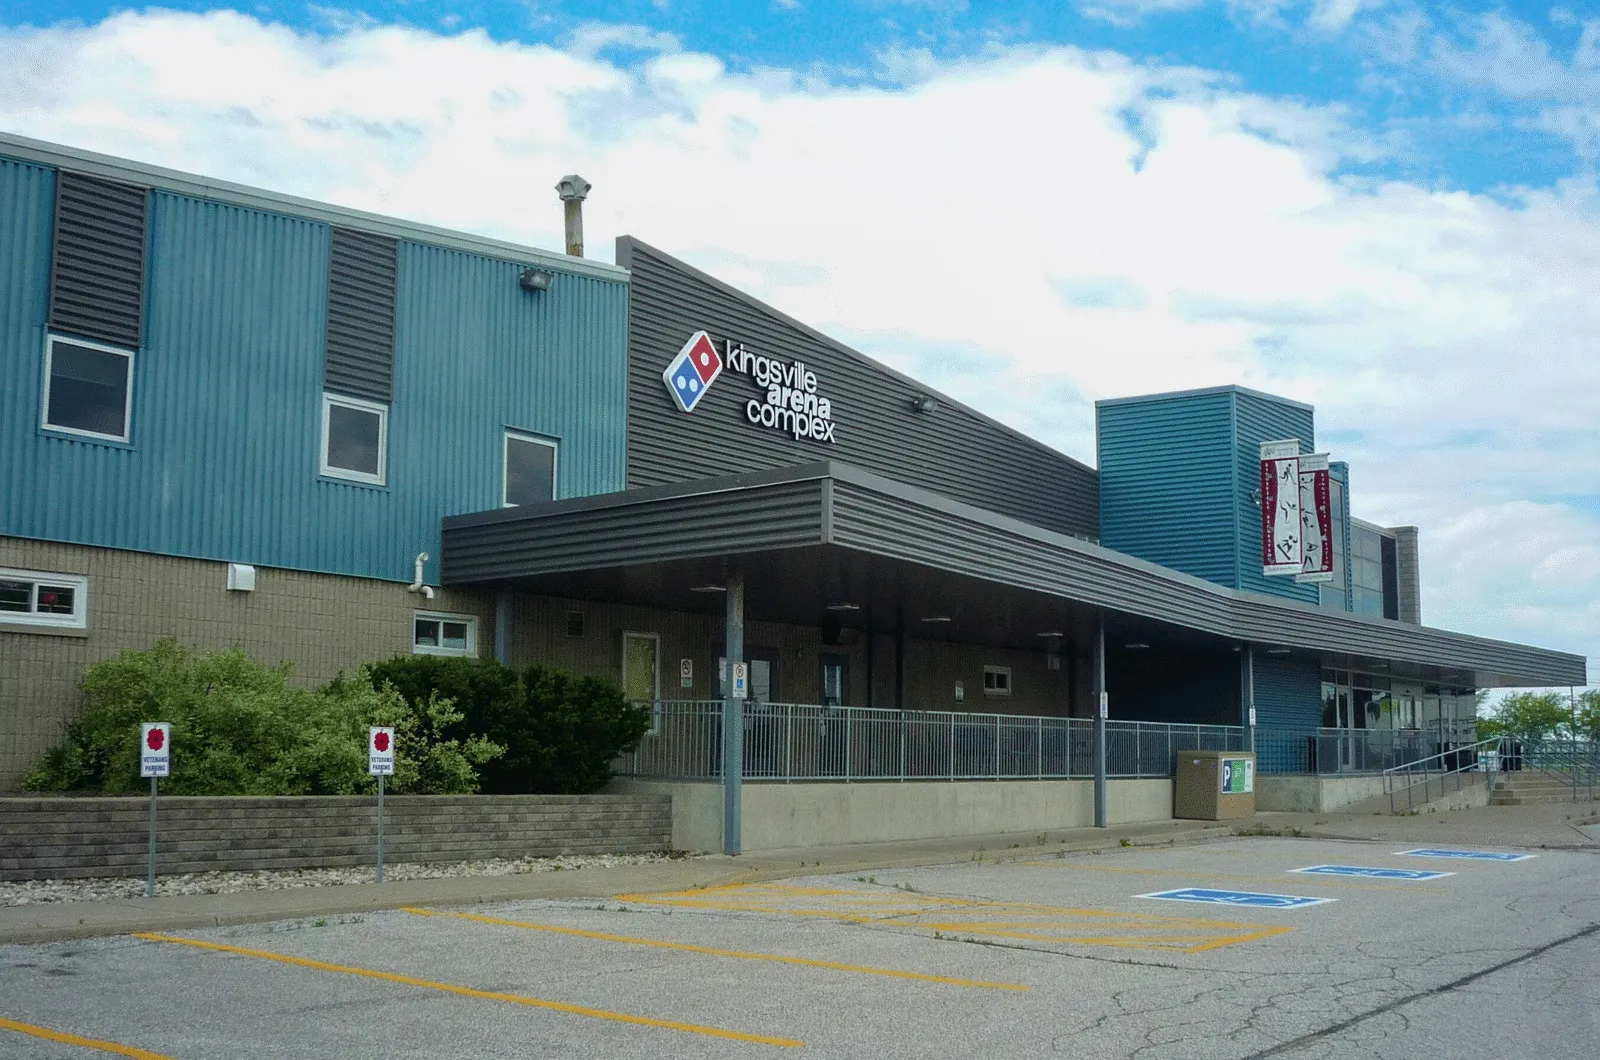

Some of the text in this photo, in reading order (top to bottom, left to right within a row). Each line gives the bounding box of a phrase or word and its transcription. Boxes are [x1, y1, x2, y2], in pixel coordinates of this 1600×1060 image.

[725, 339, 818, 394] kingsville
[746, 399, 837, 444] complex
[766, 383, 832, 420] arena
